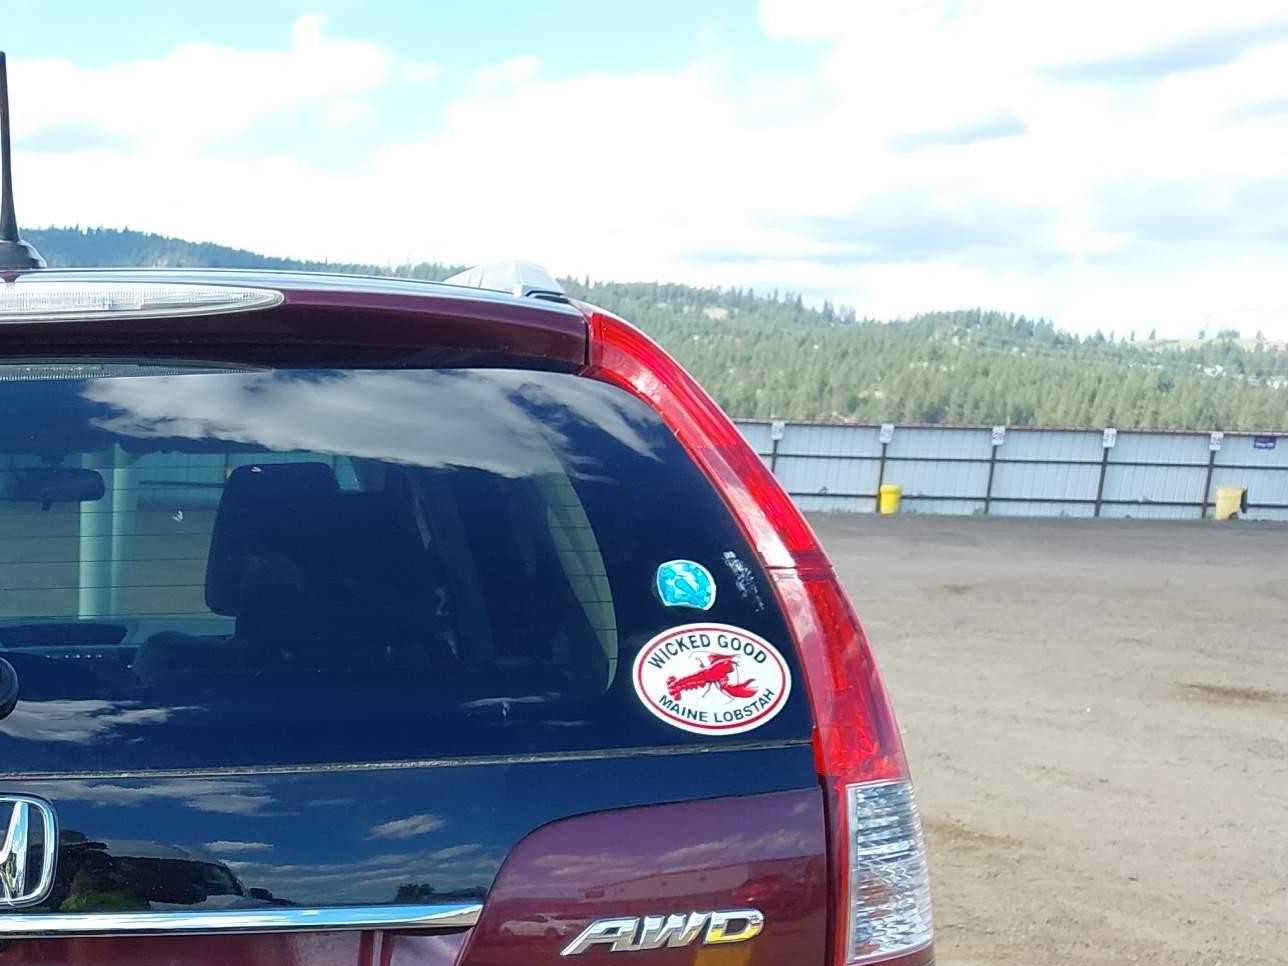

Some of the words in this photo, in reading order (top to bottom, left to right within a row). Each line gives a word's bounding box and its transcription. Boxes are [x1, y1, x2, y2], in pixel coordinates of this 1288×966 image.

[648, 634, 711, 669] WICKED
[717, 634, 768, 664] GOOD
[658, 694, 709, 723] MAINE
[714, 688, 775, 723] LOBSTAH
[559, 907, 765, 956] AWD
